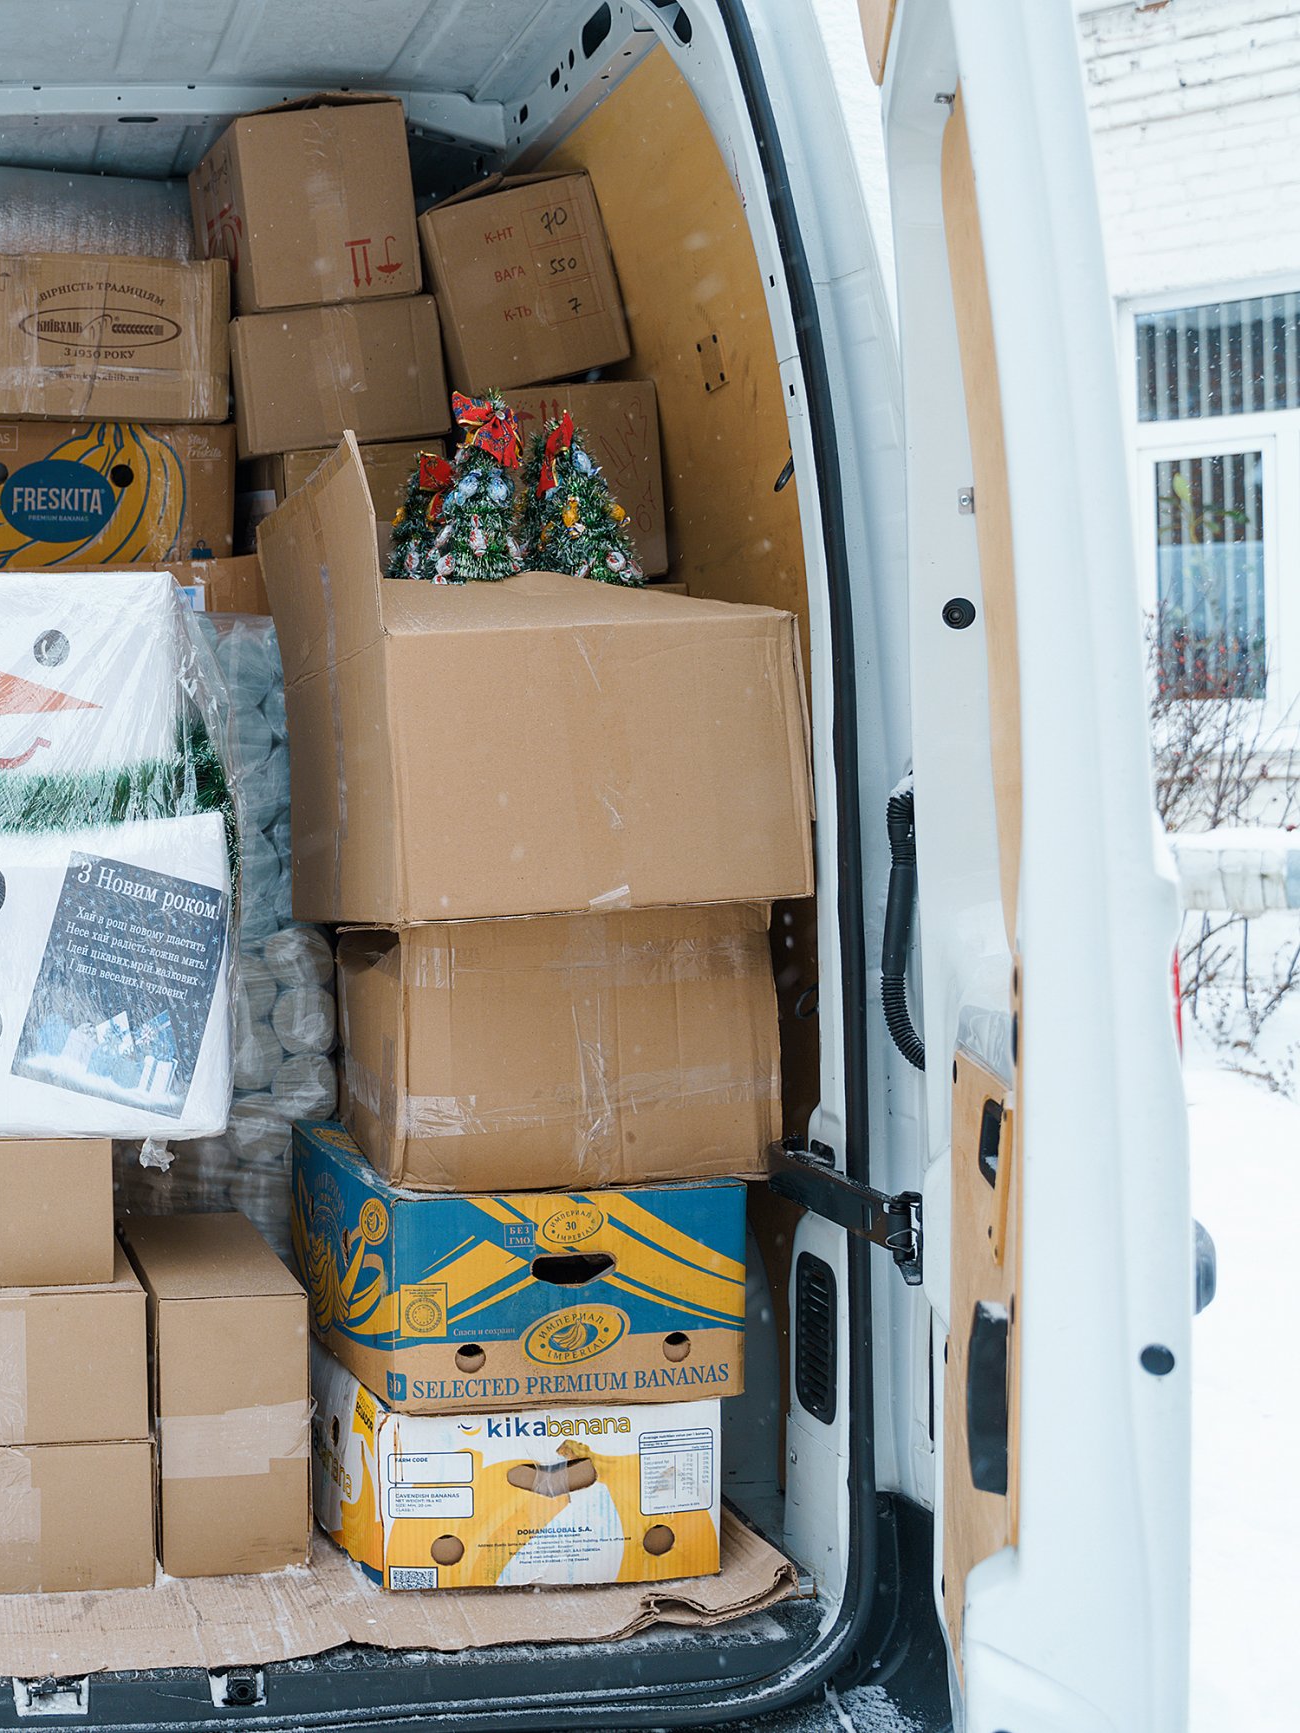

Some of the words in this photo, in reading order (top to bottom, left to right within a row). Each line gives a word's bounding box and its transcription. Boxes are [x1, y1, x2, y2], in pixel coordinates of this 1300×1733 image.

[540, 206, 568, 235] 70
[484, 226, 514, 244] К-НТ
[494, 265, 526, 283] ВАГА
[549, 257, 577, 275] 550
[38, 282, 94, 304] ВІРНІСТЬ
[96, 282, 165, 307] ТРАДИЦІЯМ
[503, 305, 532, 322] К-ТЬ
[567, 297, 582, 314] 7
[104, 349, 135, 360] РОКУ
[12, 487, 103, 515] FRESKITA
[77, 862, 93, 884] З
[96, 866, 158, 903] Новим
[161, 891, 223, 921] роком!
[76, 906, 97, 923] Хай
[97, 915, 104, 925] в
[106, 917, 127, 932] році
[129, 924, 165, 941] новому
[166, 933, 207, 953] щастить
[65, 921, 90, 938] Несе
[91, 929, 110, 944] хай
[111, 936, 180, 963] радість-кожна
[181, 957, 209, 971] мить!
[66, 939, 90, 957] Ідей
[90, 948, 154, 974] цікавих,мрій
[155, 967, 199, 986] казкових
[75, 963, 98, 977] днів
[146, 981, 189, 1001] чудових!
[550, 1209, 592, 1228] ИМПЕРИАЛ
[565, 1221, 577, 1231] 30
[509, 1226, 530, 1235] БЕЗ
[556, 1226, 594, 1241] IMPERIAL
[509, 1237, 531, 1245] ГМО
[453, 1327, 477, 1337] Спаси
[538, 1312, 605, 1340] ИМПЕРИАЛ
[546, 1337, 607, 1362] IMPERIAL
[412, 1377, 520, 1400] SELECTED
[525, 1370, 628, 1394] PREMIUM
[633, 1362, 729, 1389] BANANAS
[487, 1415, 632, 1438] kikabanana
[517, 1527, 577, 1536] DOMANIGLOBAL
